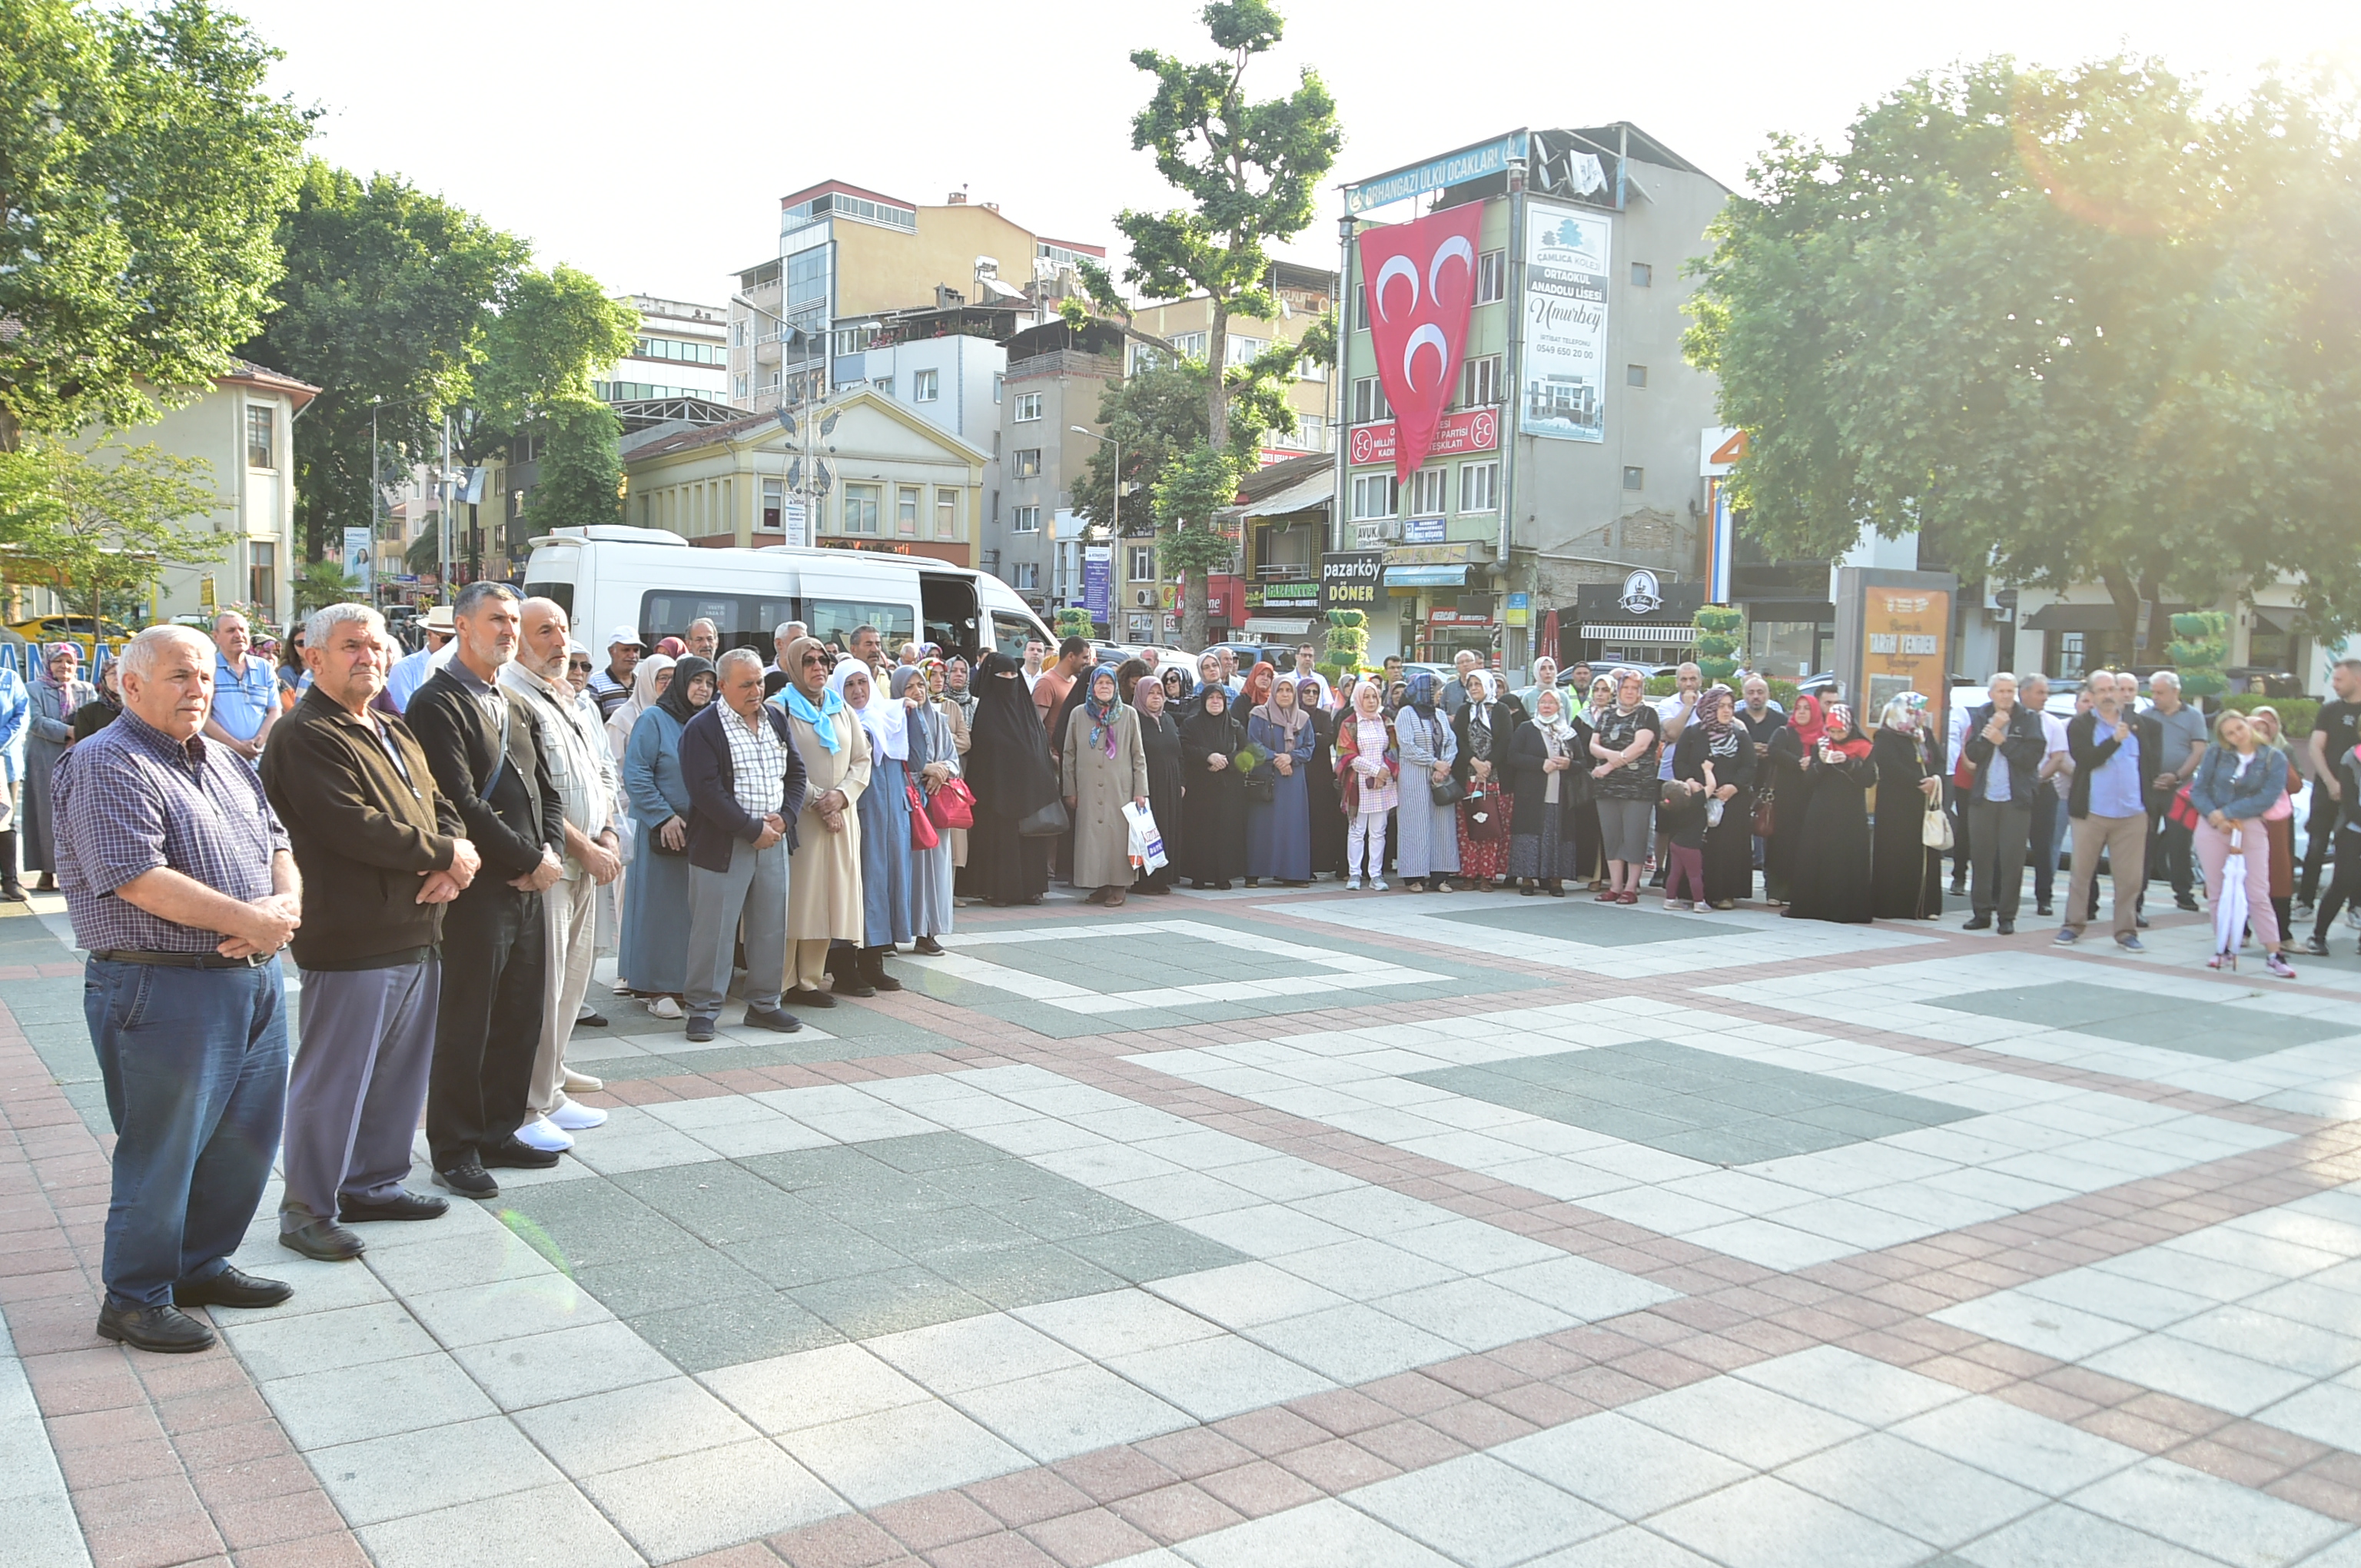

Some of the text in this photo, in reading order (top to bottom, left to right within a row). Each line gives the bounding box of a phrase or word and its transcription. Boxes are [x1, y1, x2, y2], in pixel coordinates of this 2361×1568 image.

[1366, 171, 1419, 206] ORHANGAZİ
[1420, 161, 1446, 189] ÜLKÜ
[1537, 253, 1572, 264] ÇAMLICA
[1544, 268, 1591, 285] ORTAOKUL
[1531, 281, 1602, 301] ANADOLU LİSESİ
[1530, 297, 1602, 333] Umurbey
[1562, 337, 1591, 347] TELEFONU
[1536, 344, 1593, 360] 0549 650 20 00
[1442, 426, 1468, 438] PARTİSİ
[1373, 437, 1396, 448] MİLLİY
[1358, 527, 1379, 538] AVUK
[1323, 557, 1382, 582] pazarköy
[1329, 581, 1374, 602] DÖNER
